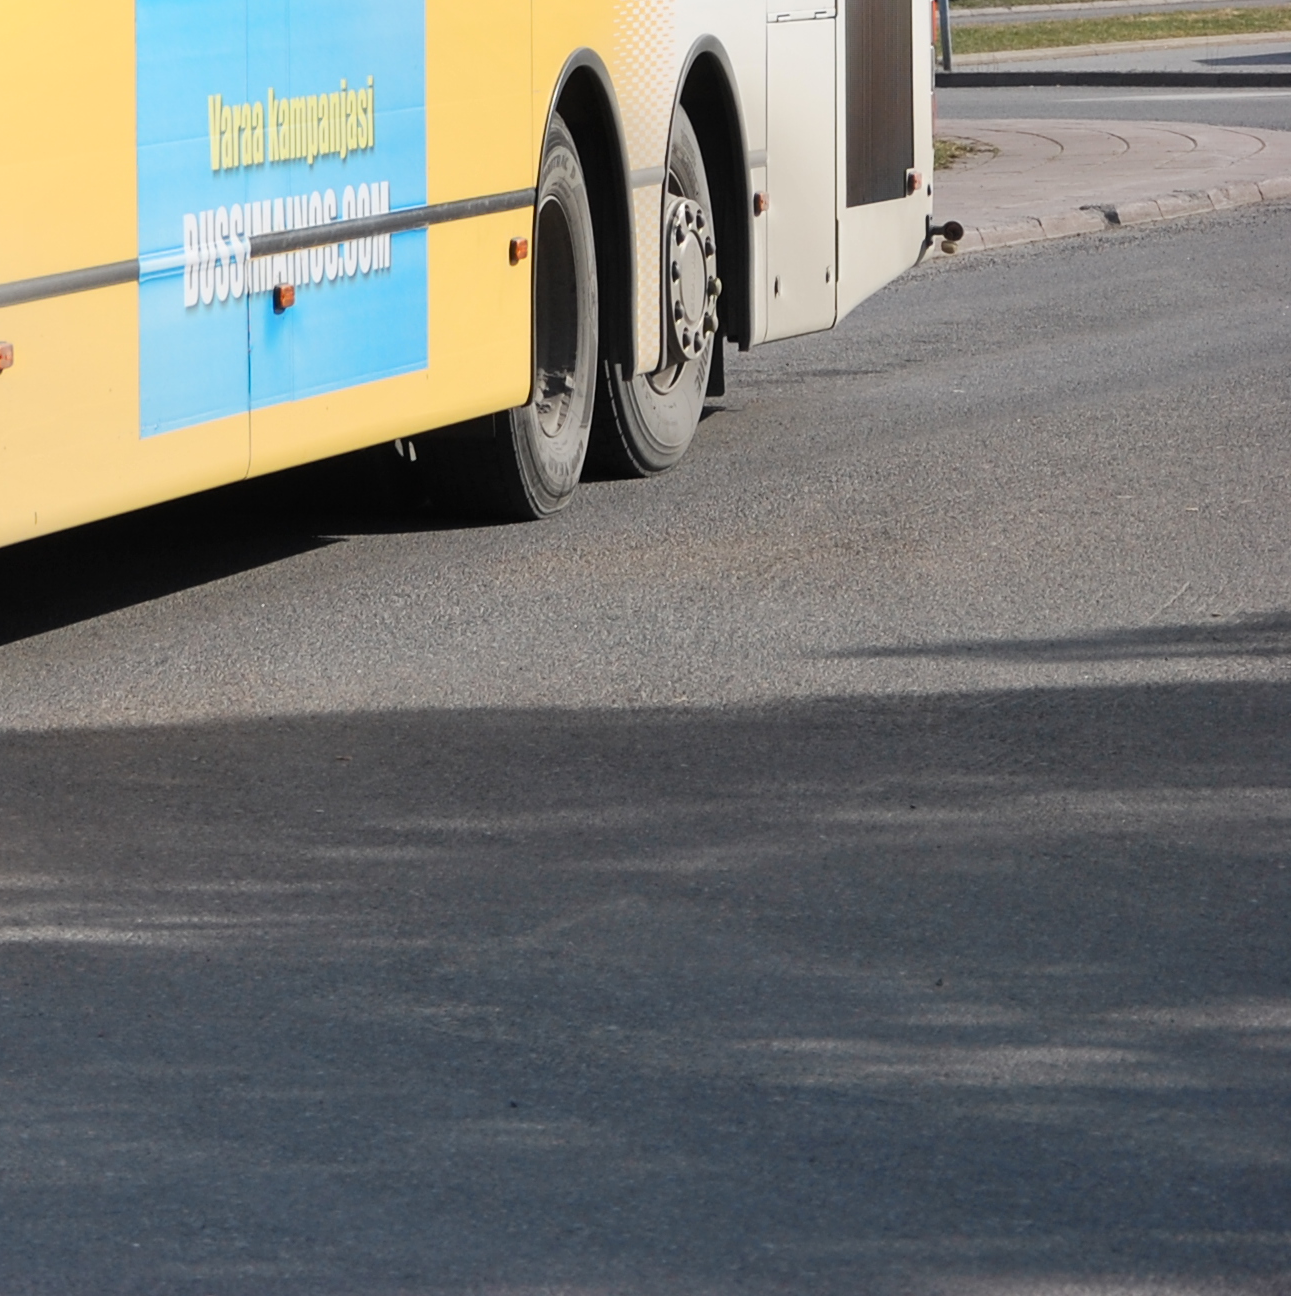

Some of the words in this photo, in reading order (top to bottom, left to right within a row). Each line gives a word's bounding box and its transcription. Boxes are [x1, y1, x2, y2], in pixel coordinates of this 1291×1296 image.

[208, 93, 265, 171] Varaa
[267, 74, 375, 165] kampanjasi
[182, 180, 393, 309] BUSSIMAINOS.COM
